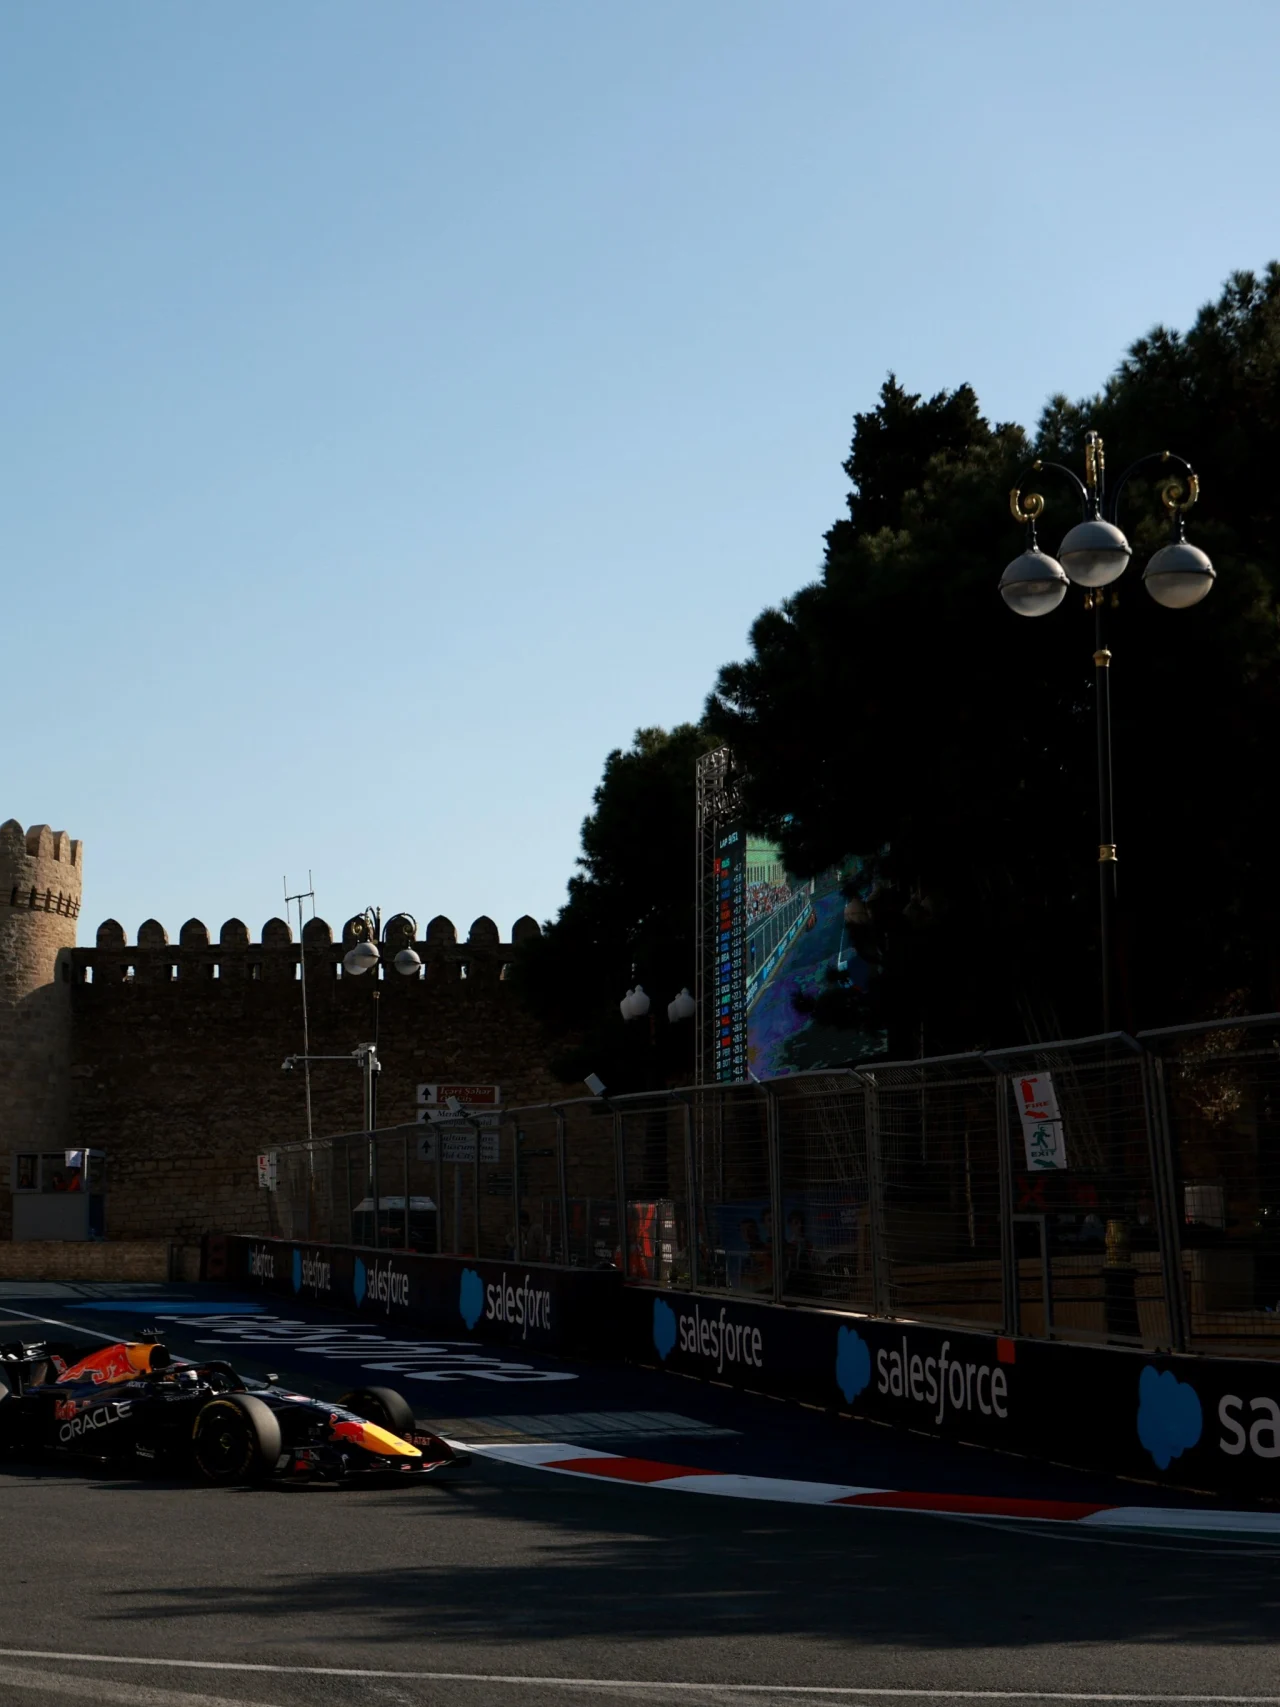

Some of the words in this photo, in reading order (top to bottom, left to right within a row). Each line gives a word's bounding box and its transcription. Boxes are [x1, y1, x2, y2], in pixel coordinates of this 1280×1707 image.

[1025, 1101, 1049, 1109] FIRE
[367, 1258, 409, 1315] salesforce
[486, 1271, 551, 1340] salesforce
[679, 1304, 763, 1374] salesforce
[876, 1335, 1009, 1426] salesforce
[59, 1401, 133, 1442] ORACLE
[413, 1436, 432, 1446] AT&T
[1218, 1393, 1280, 1459] sa
